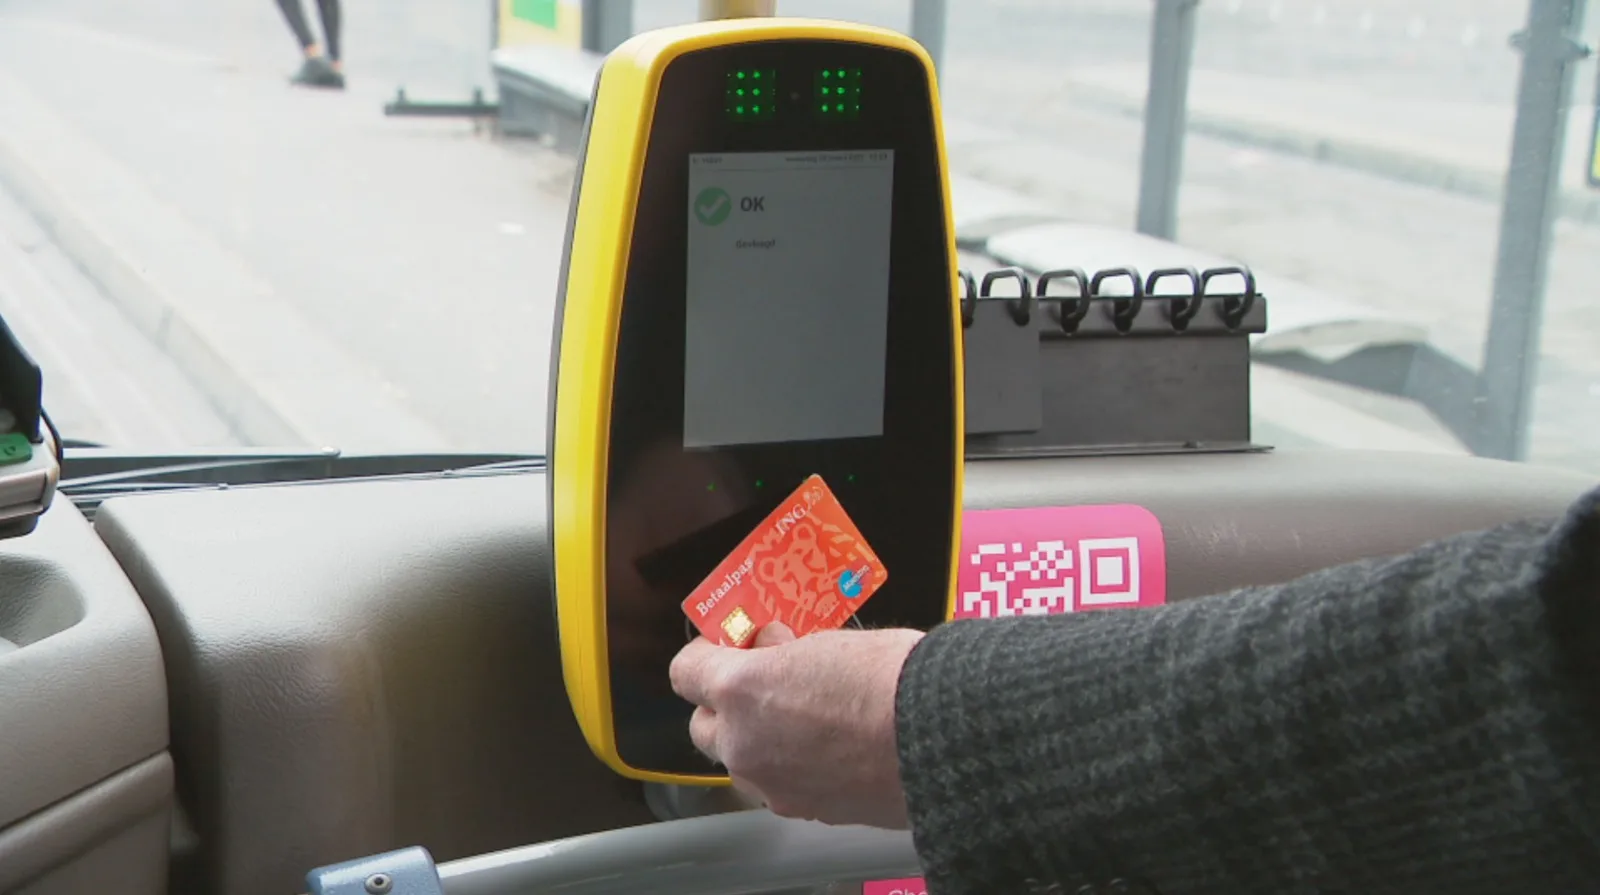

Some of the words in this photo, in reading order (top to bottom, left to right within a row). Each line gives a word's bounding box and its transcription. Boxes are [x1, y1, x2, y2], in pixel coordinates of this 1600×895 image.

[740, 196, 765, 212] OK
[774, 503, 807, 536] ING
[695, 556, 754, 617] Betaalpas
